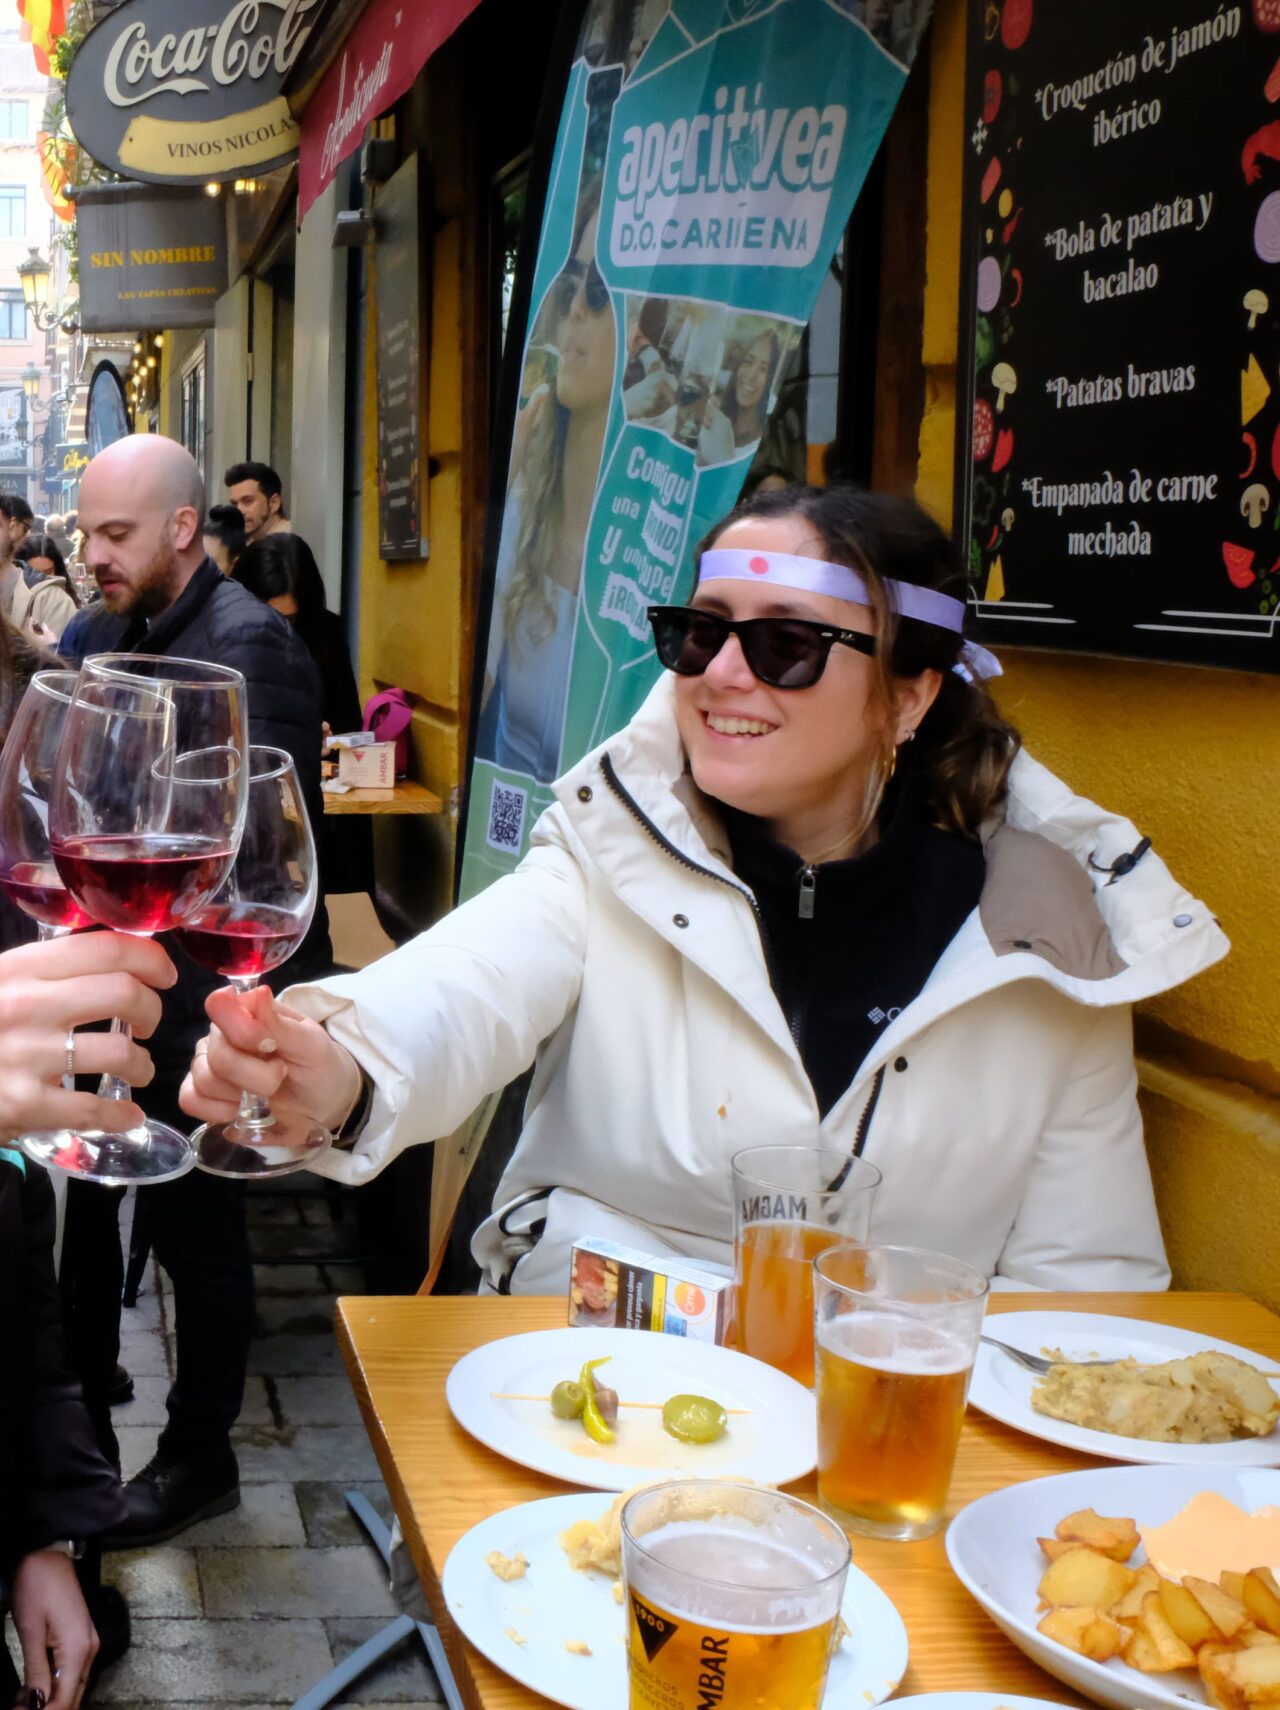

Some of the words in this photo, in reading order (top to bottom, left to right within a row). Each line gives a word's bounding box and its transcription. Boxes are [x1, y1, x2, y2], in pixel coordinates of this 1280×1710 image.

[1141, 36, 1166, 73] de
[1165, 4, 1240, 73] jamón
[1093, 99, 1161, 146] ibérico
[168, 141, 222, 159] VINOS
[661, 202, 807, 250] CARIENA
[1100, 213, 1122, 248] de
[1127, 196, 1193, 251] patata
[1195, 192, 1213, 231] y
[90, 251, 124, 268] SIN
[130, 246, 215, 267] NOMBRE
[1083, 258, 1159, 304] bacalao
[1127, 364, 1196, 399] bravas
[1129, 468, 1153, 503] de
[1157, 474, 1218, 503] carne
[612, 496, 640, 520] una
[600, 526, 622, 565] y
[1068, 521, 1152, 558] mechada
[696, 1635, 730, 1710] MBAR
